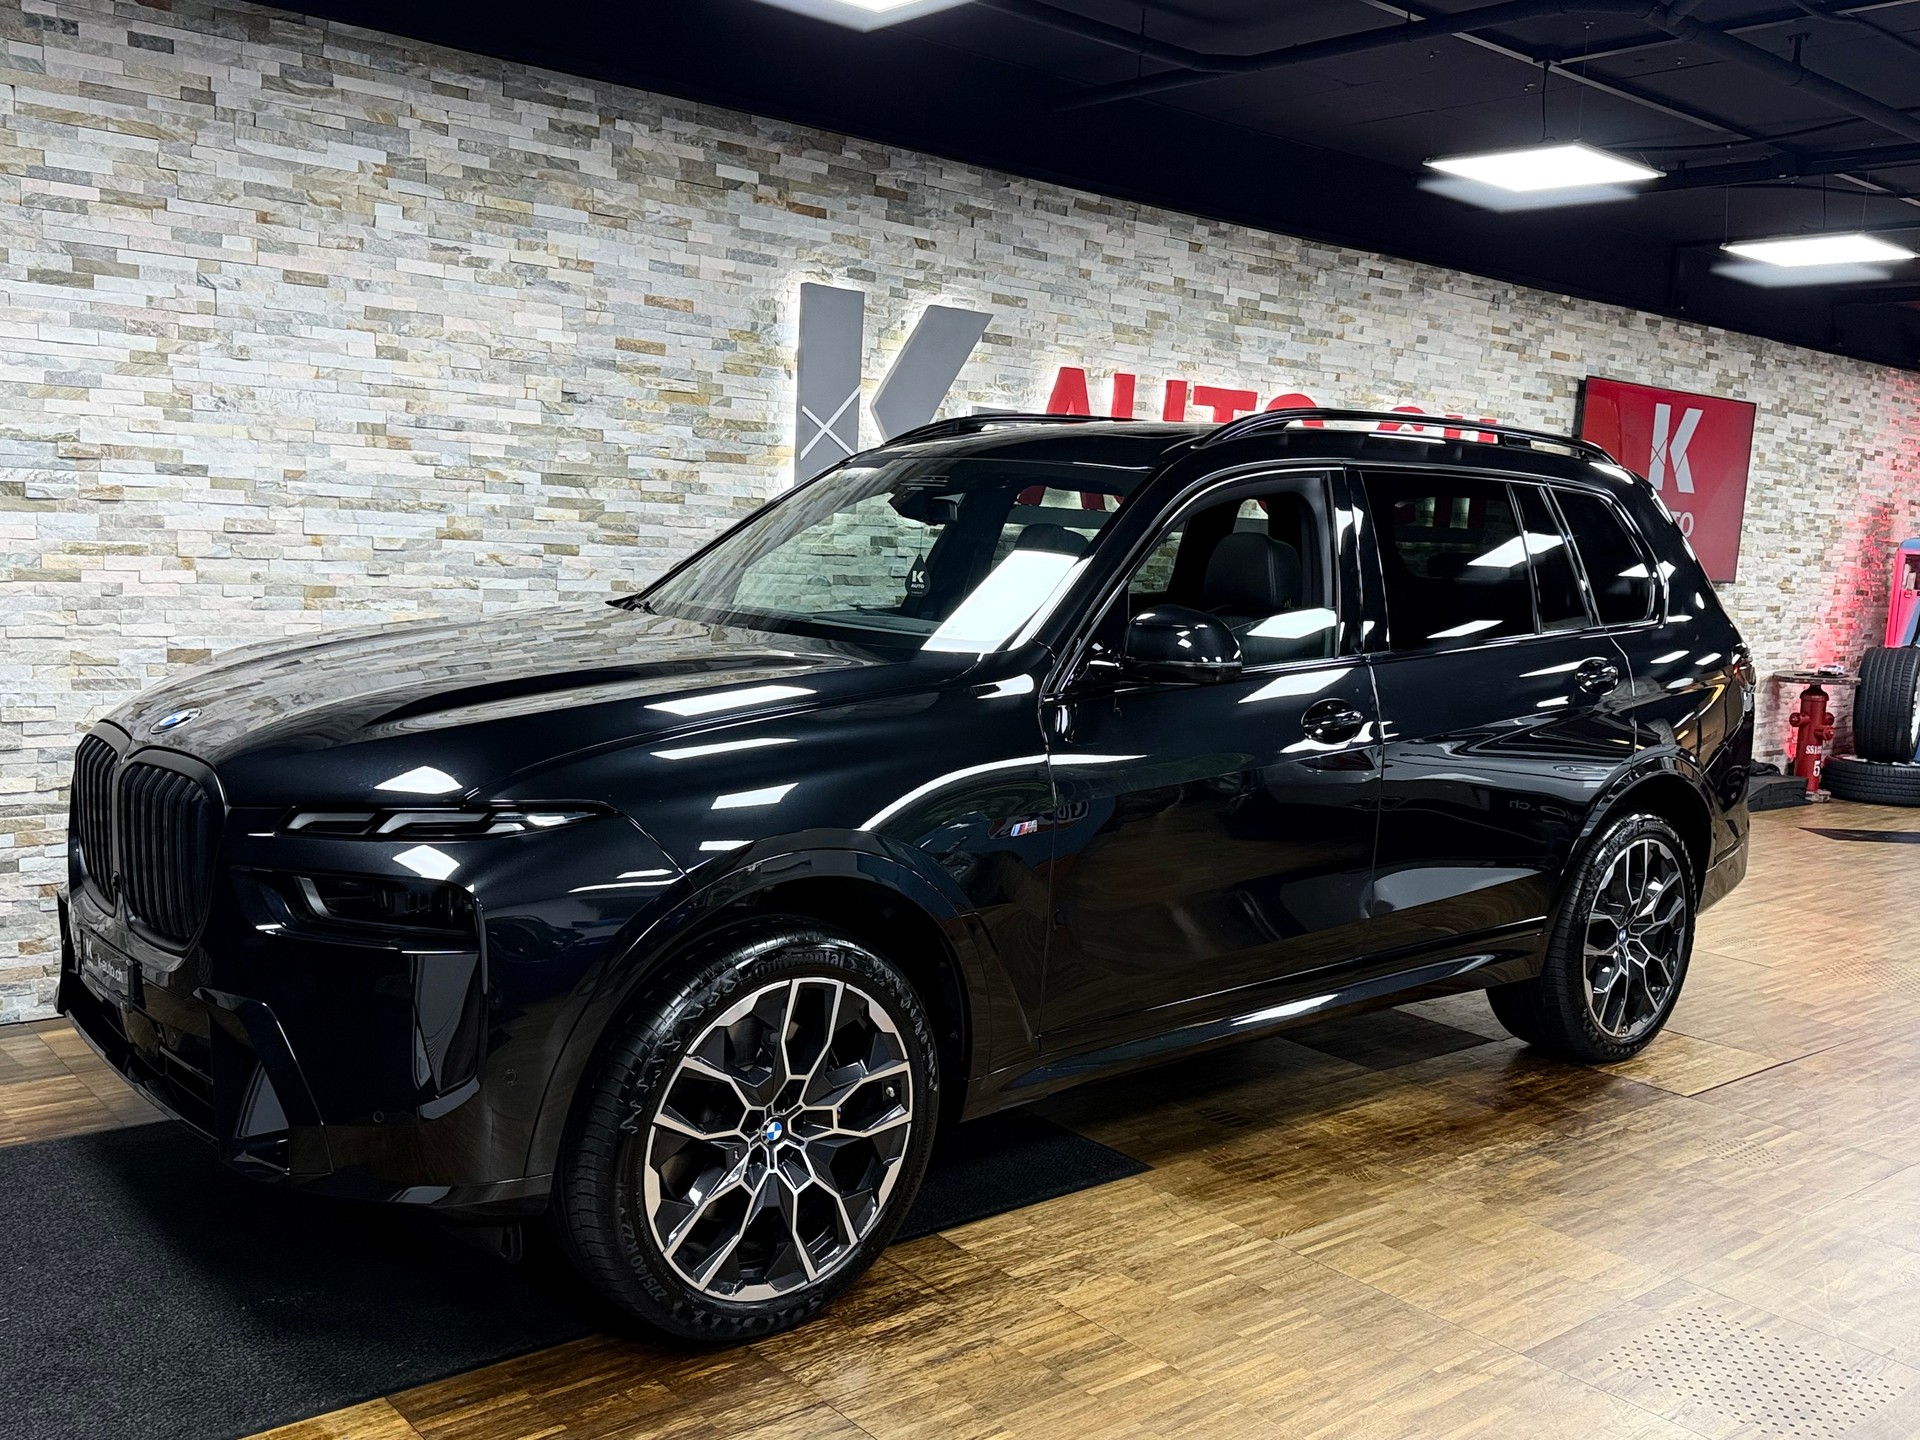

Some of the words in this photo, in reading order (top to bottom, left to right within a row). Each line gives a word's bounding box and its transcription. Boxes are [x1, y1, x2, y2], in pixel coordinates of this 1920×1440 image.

[794, 282, 994, 487] K
[1648, 403, 1703, 493] K
[912, 570, 925, 583] K
[751, 950, 848, 981] Continental
